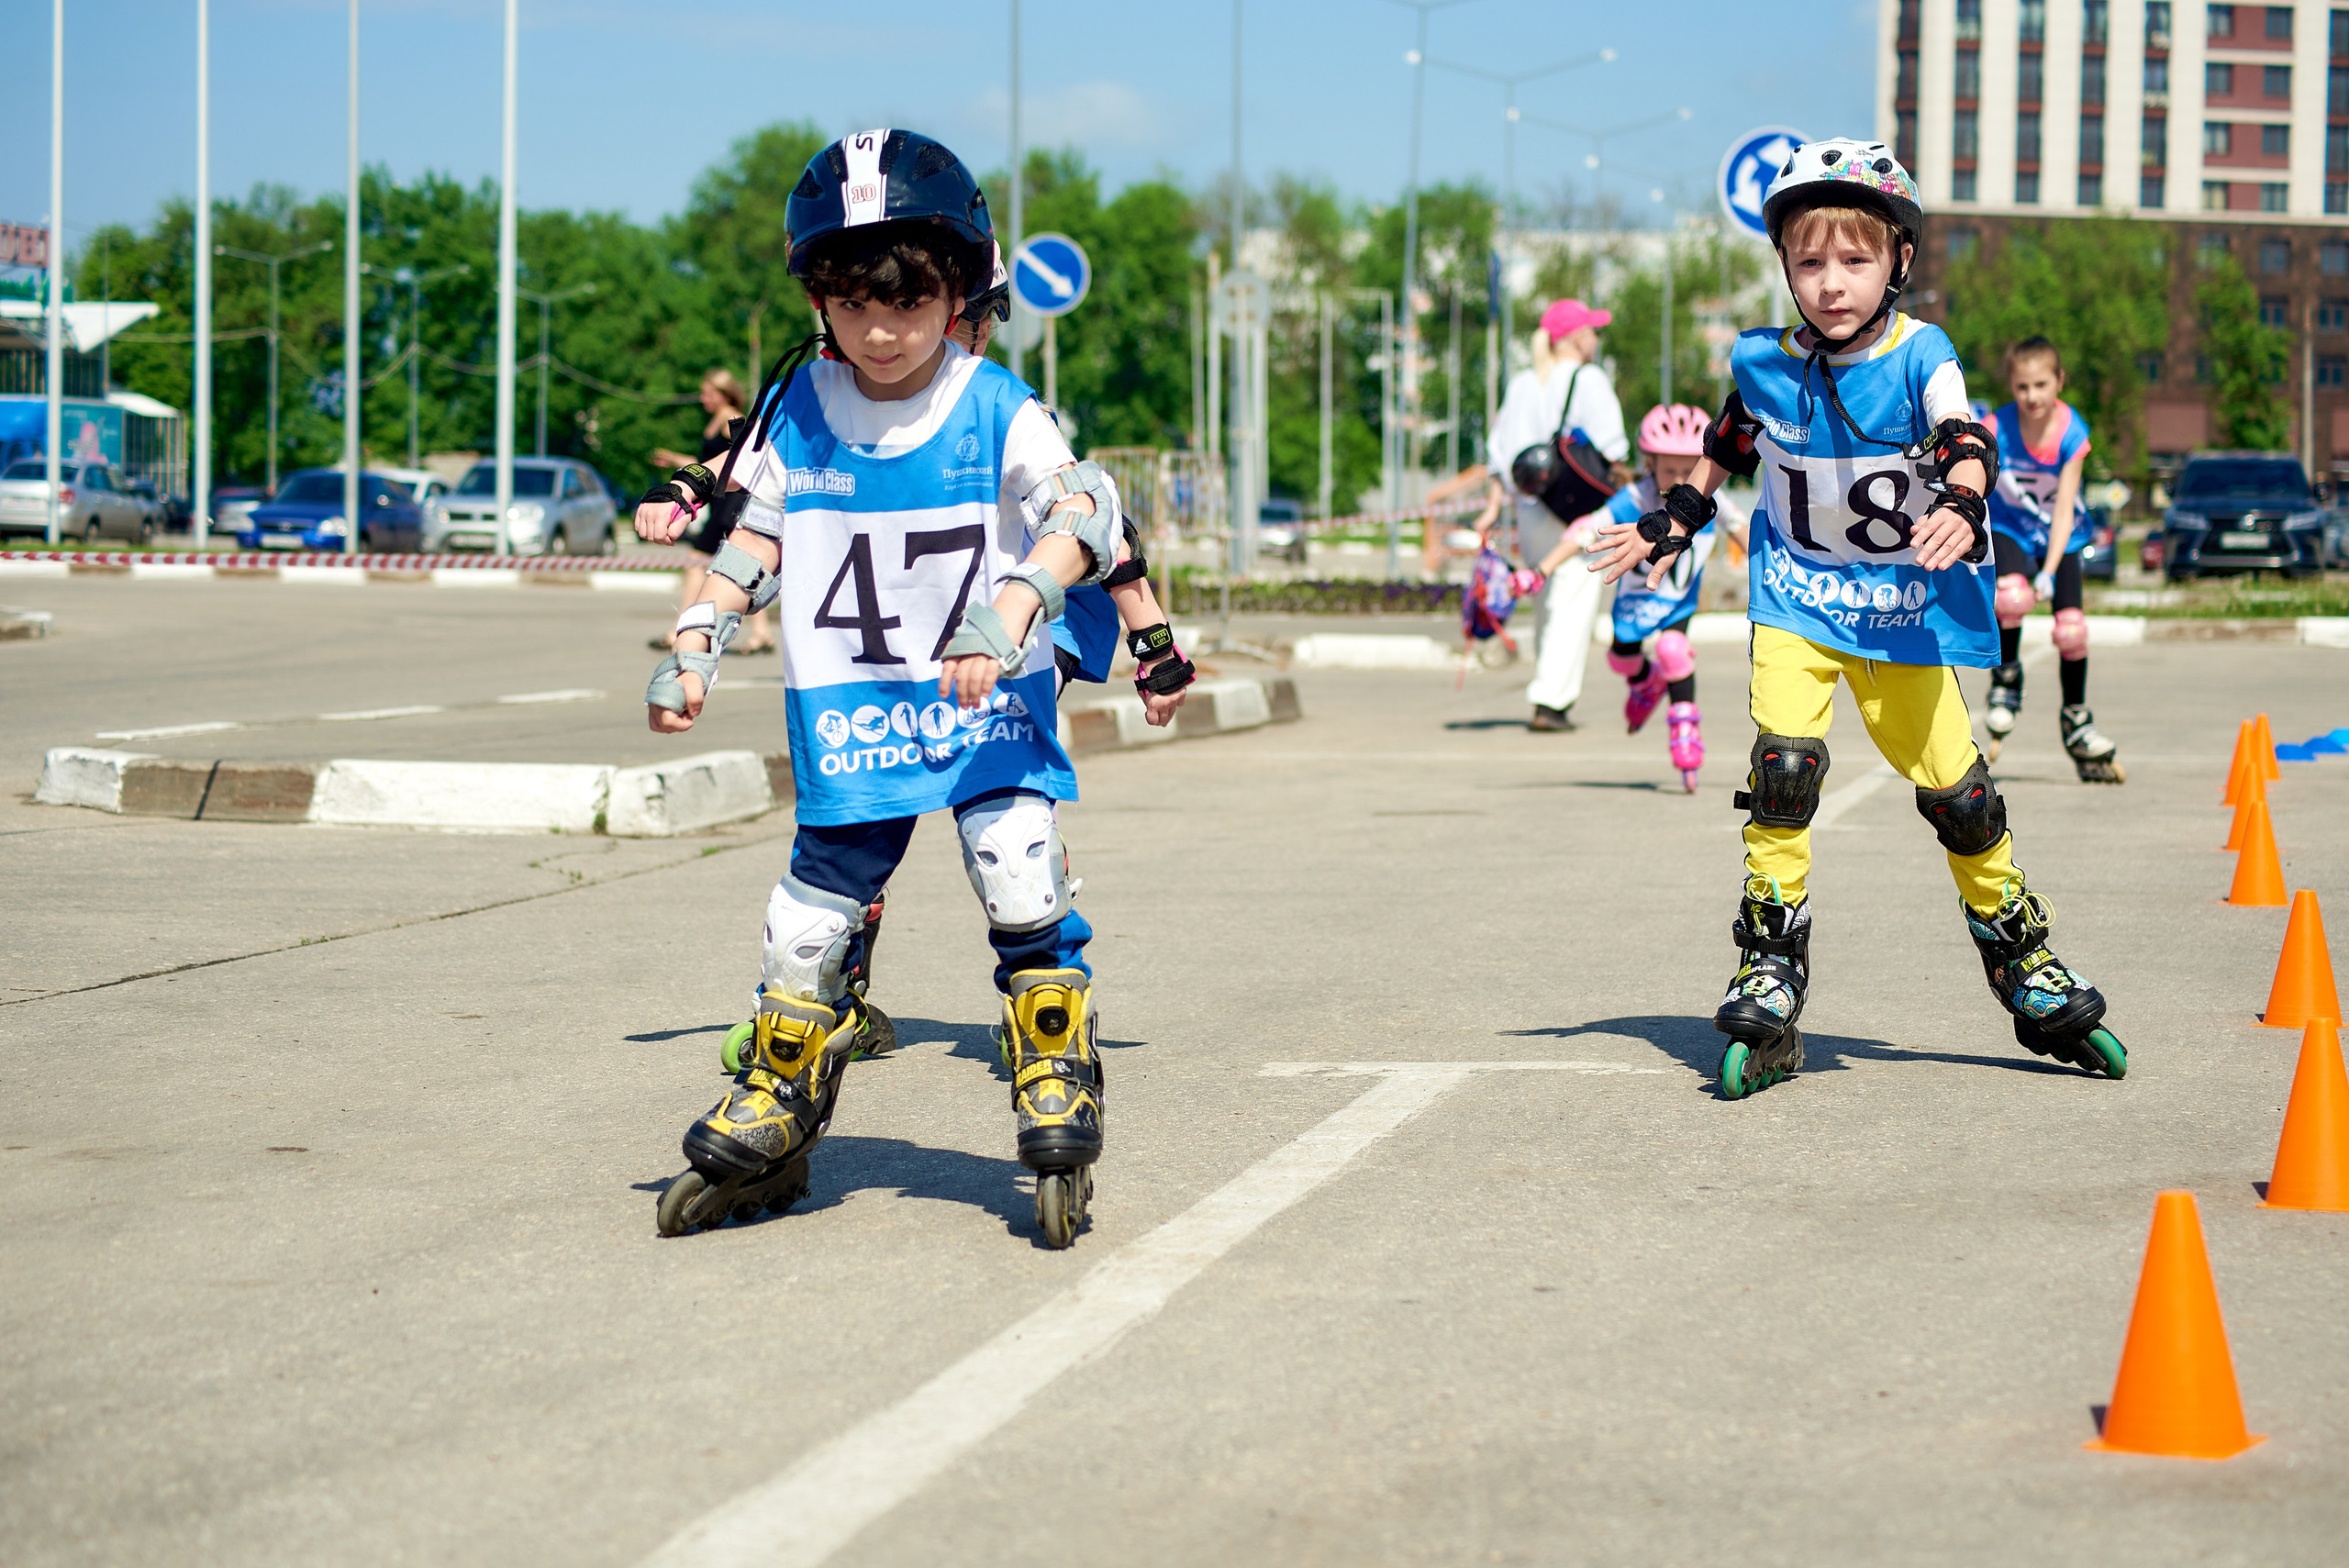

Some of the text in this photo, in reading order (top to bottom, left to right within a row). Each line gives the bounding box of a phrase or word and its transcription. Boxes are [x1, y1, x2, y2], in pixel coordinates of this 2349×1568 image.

[852, 184, 876, 204] 10
[1779, 423, 1808, 441] Class
[789, 471, 853, 494] World Class
[1778, 463, 1915, 554] 18
[814, 524, 985, 664] 47
[1866, 610, 1923, 629] TEAM
[819, 721, 1034, 776] OUTDOOR TEAM
[1751, 964, 1777, 973] SPLASH
[1016, 1059, 1052, 1086] RAIDER
